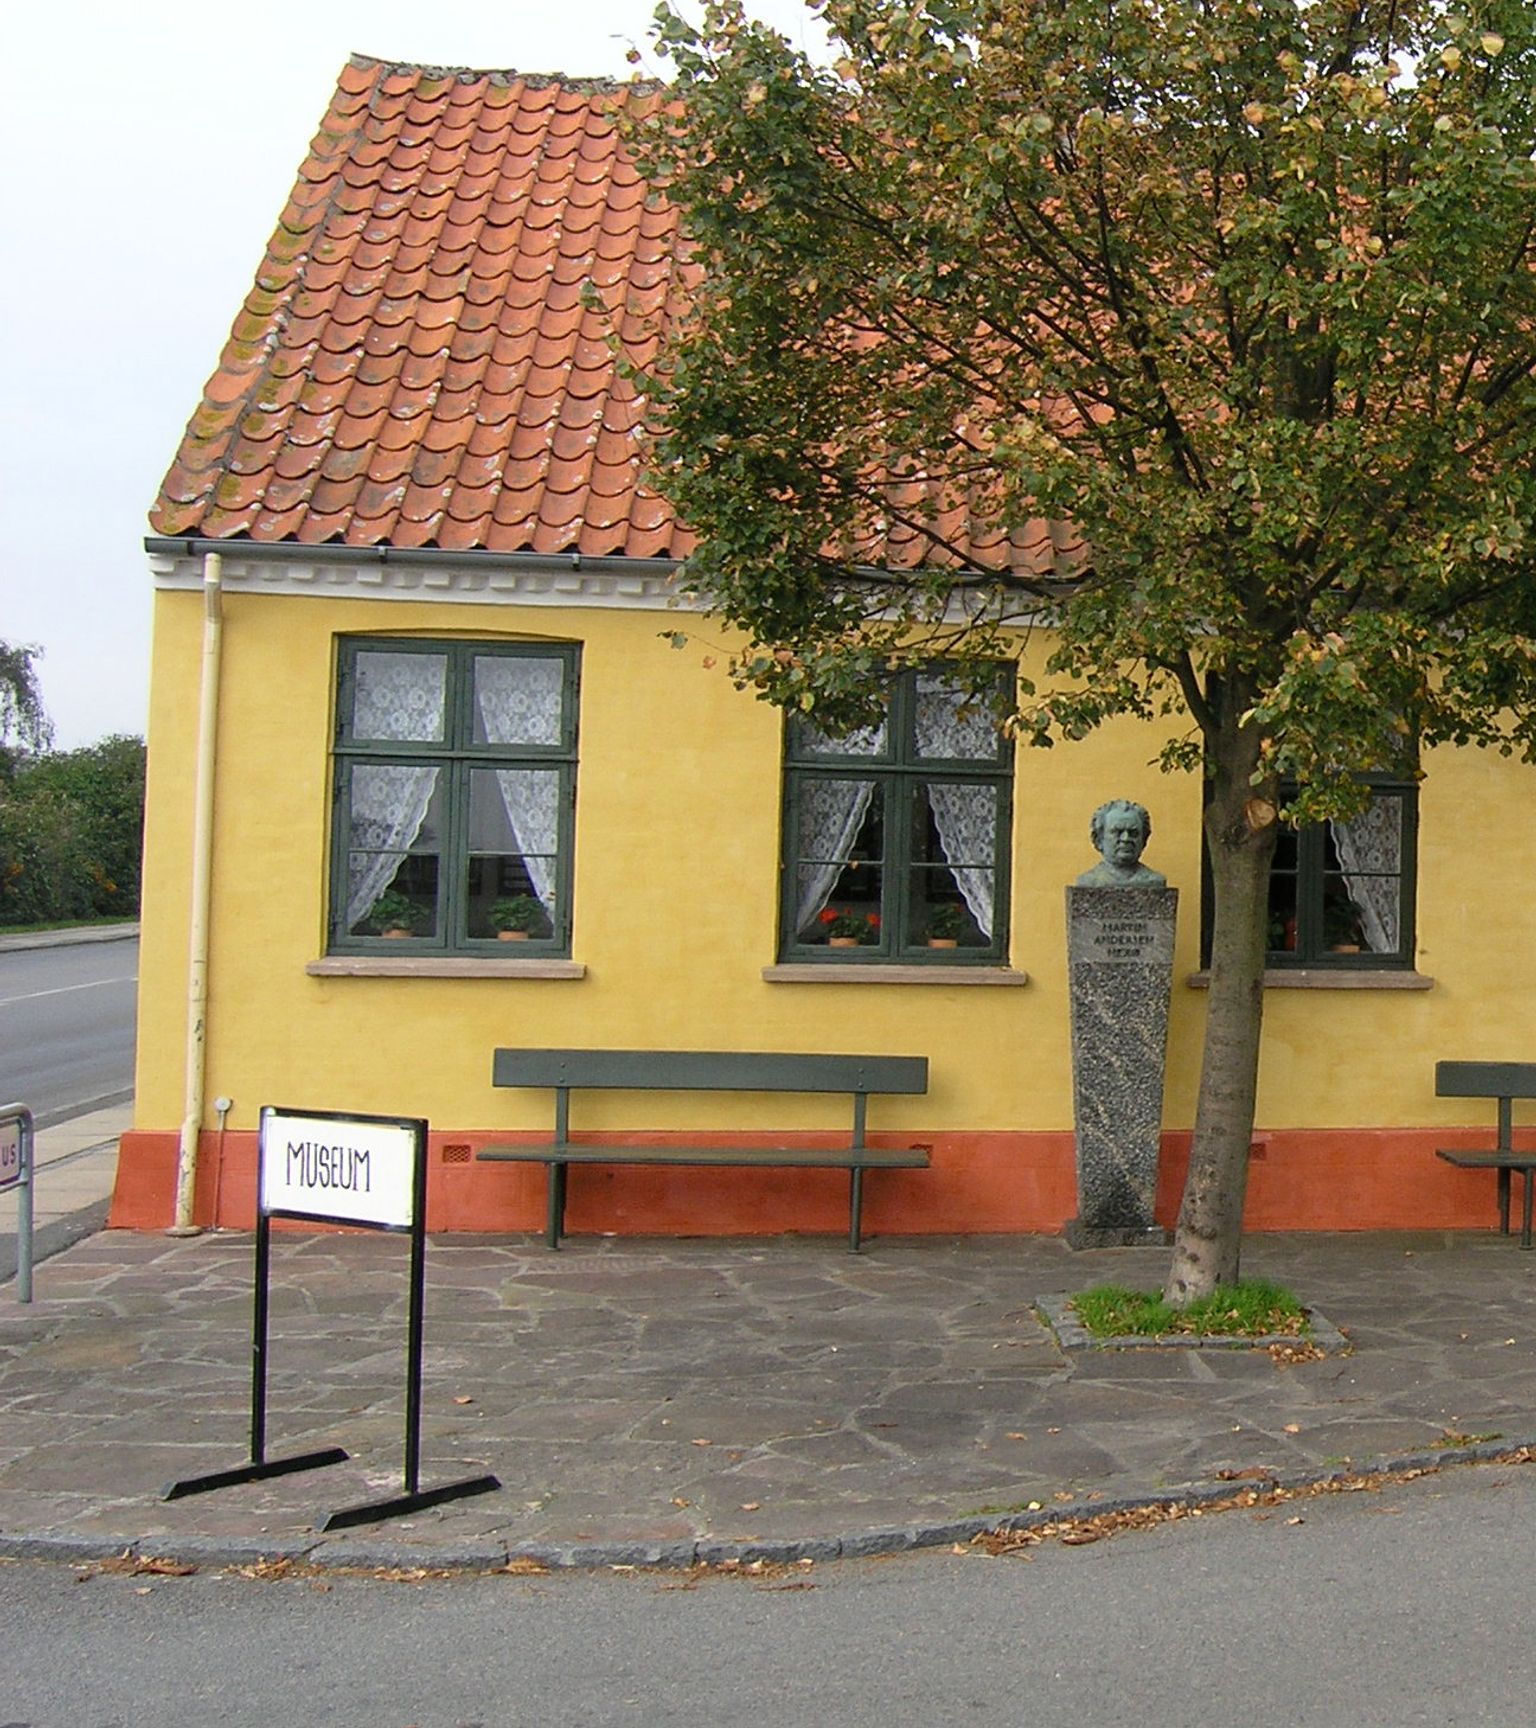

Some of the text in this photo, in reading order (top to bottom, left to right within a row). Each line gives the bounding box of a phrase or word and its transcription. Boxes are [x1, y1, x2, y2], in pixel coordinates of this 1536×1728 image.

[1102, 923, 1148, 932] MARTIN
[1093, 935, 1155, 945] ANDERSEN
[286, 1141, 370, 1192] MUSEUM
